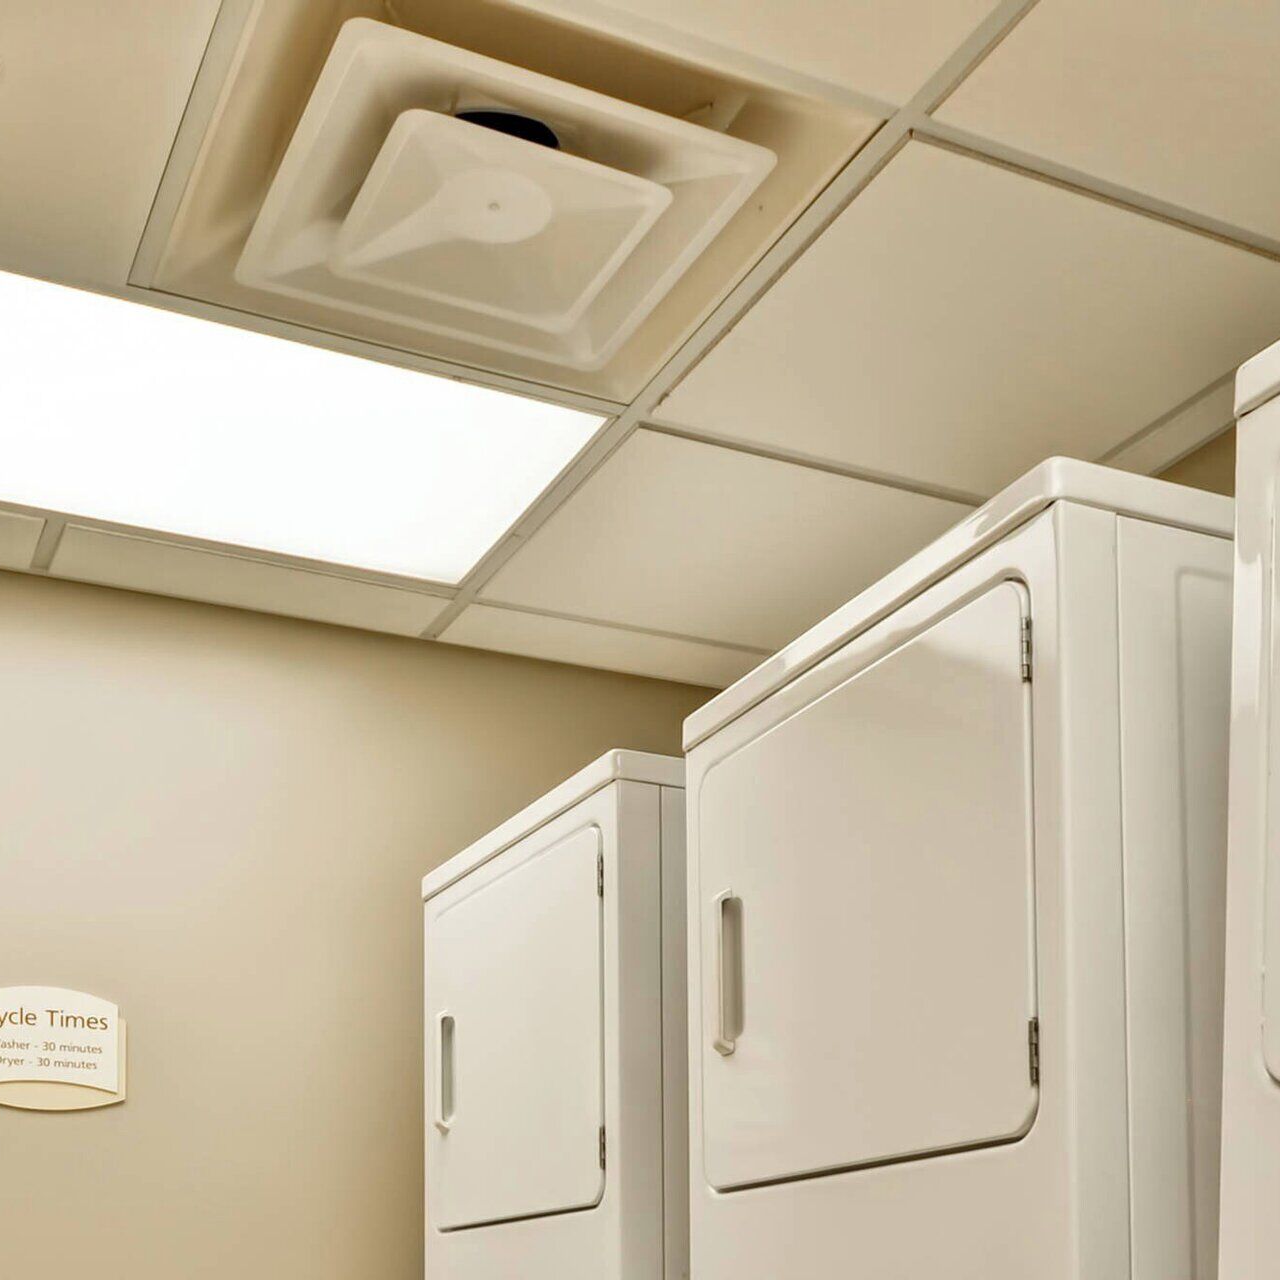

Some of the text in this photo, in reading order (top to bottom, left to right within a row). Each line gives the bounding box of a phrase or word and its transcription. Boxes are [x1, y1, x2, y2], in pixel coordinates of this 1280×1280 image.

[45, 1009, 108, 1031] Times
[42, 1041, 56, 1052] 30
[59, 1043, 103, 1055] minutes
[36, 1057, 50, 1068] 30
[53, 1059, 97, 1070] minutes
